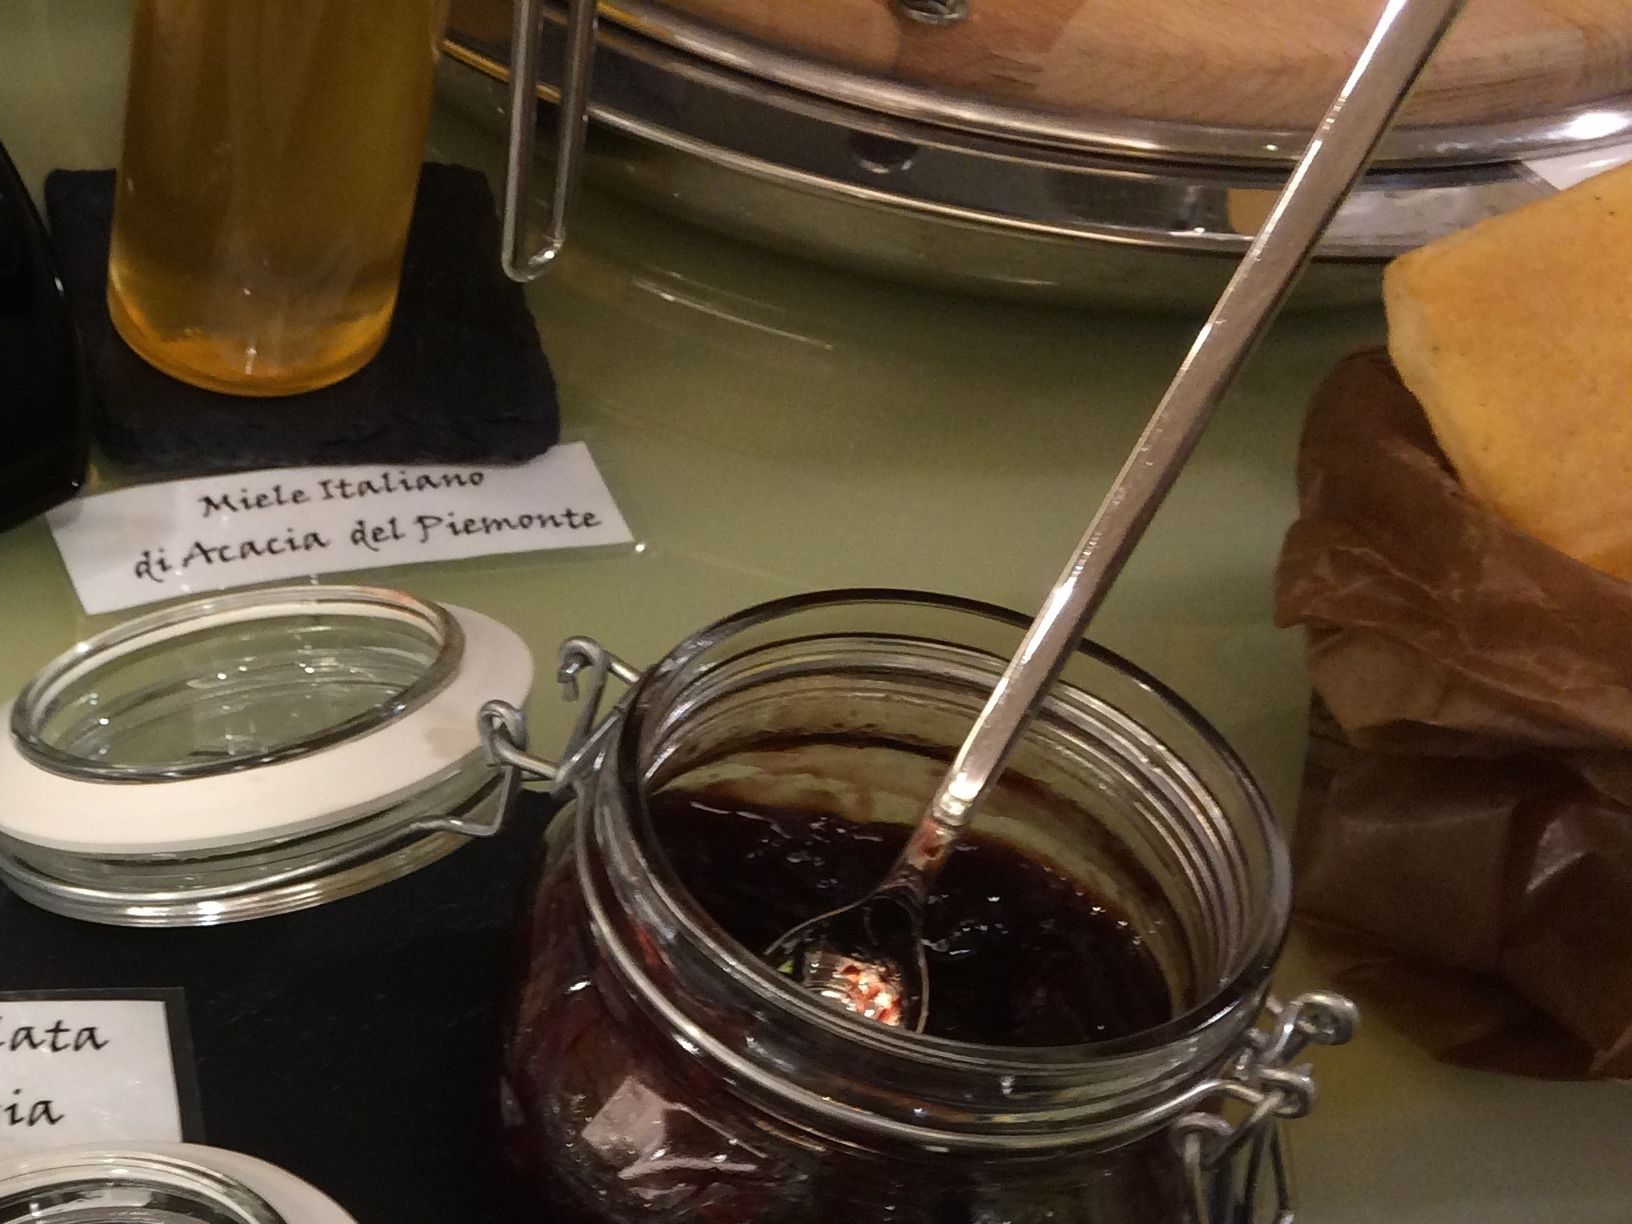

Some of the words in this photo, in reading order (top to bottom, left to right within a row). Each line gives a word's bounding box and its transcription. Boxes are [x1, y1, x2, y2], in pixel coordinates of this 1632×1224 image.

[198, 484, 311, 518] Miele
[318, 470, 485, 500] Italiano
[134, 549, 172, 582] di
[182, 528, 332, 567] Acacia
[350, 517, 406, 552] del
[415, 508, 603, 543] Piemonte
